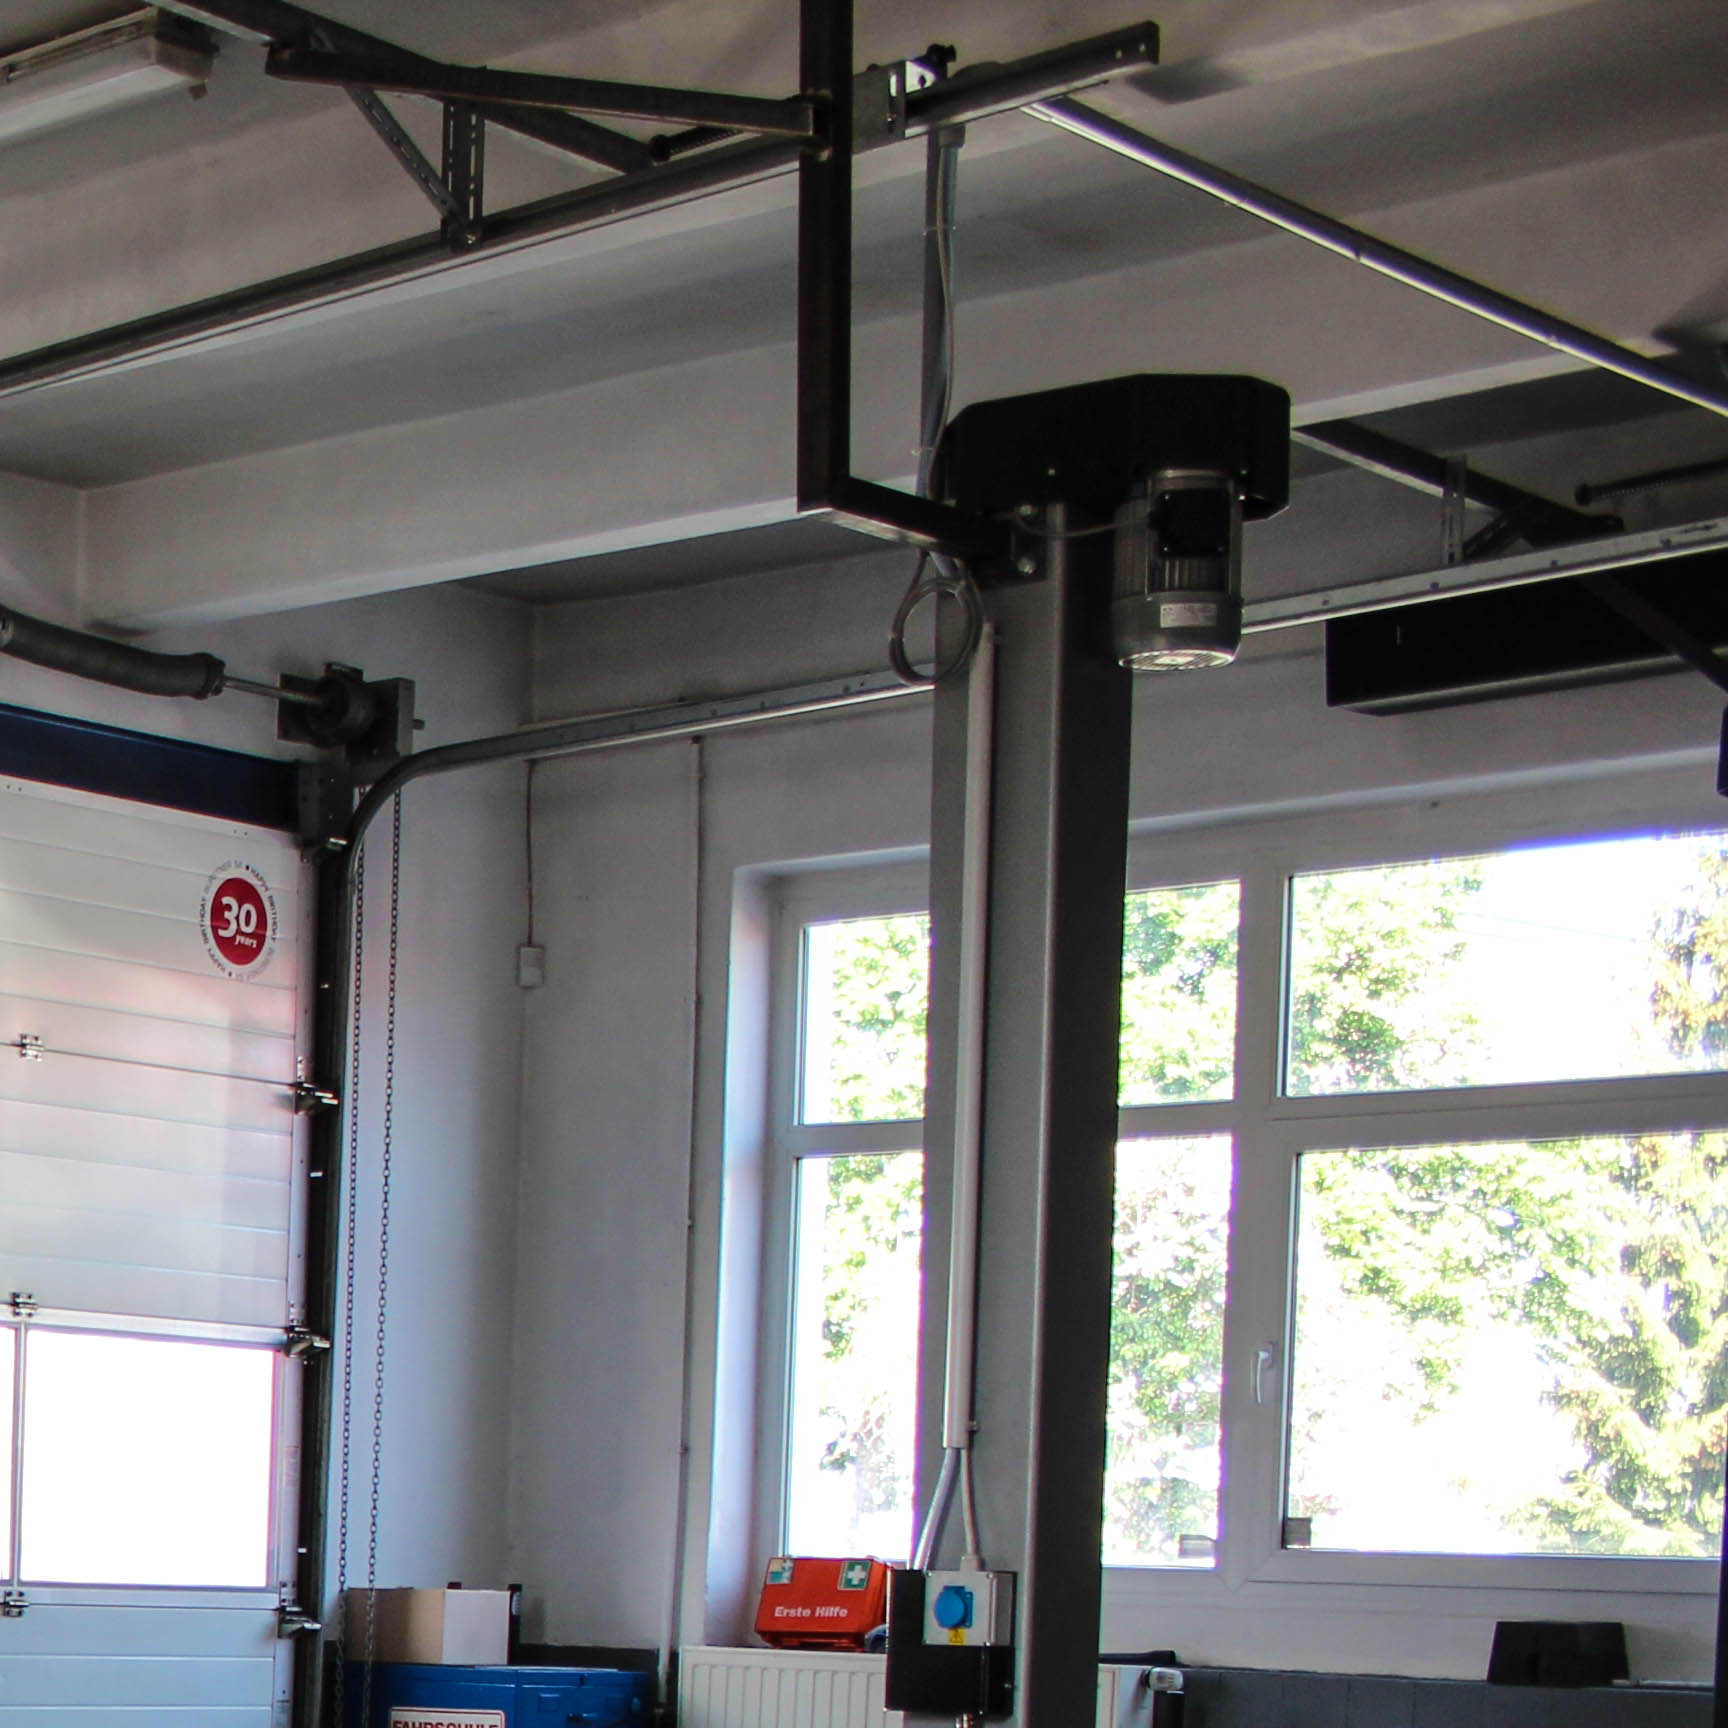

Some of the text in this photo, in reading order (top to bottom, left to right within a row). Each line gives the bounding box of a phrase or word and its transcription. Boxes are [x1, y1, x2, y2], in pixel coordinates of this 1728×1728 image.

[218, 896, 257, 937] 30
[775, 1606, 848, 1617] Erste Hilfe
